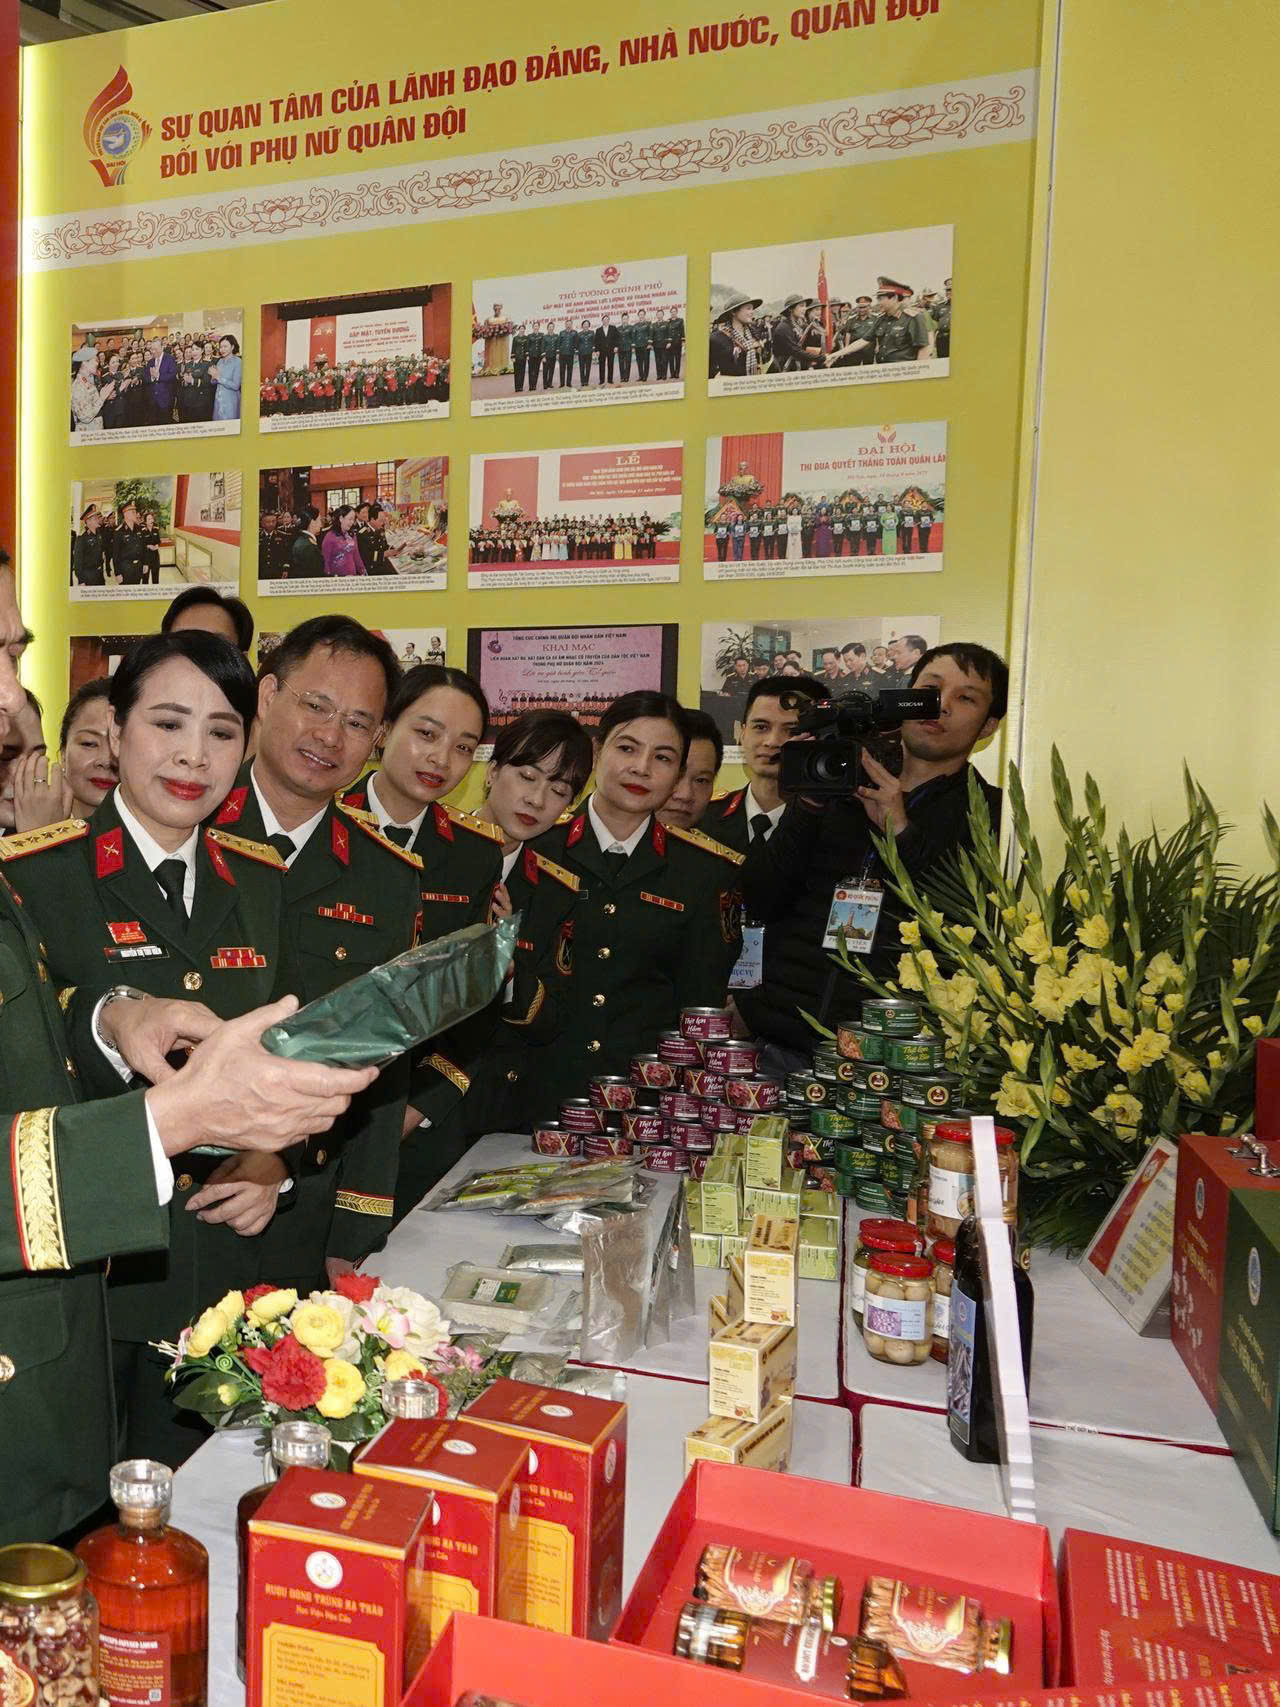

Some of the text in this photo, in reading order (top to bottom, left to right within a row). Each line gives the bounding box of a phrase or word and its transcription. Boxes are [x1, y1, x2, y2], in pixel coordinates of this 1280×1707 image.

[161, 113, 193, 141] SỰ
[199, 103, 261, 138] QUAN
[270, 93, 323, 124] TÂM
[331, 79, 380, 114] CỦA
[389, 71, 455, 105] LÃNH
[463, 59, 516, 93] ĐẠO
[525, 45, 609, 82] ĐẢNG,
[620, 27, 678, 67] NHÀ
[688, 13, 779, 55] NƯỚC,
[160, 105, 466, 179] ĐỐI VỚI PHỤ NỮ QUÂN ĐỘI
